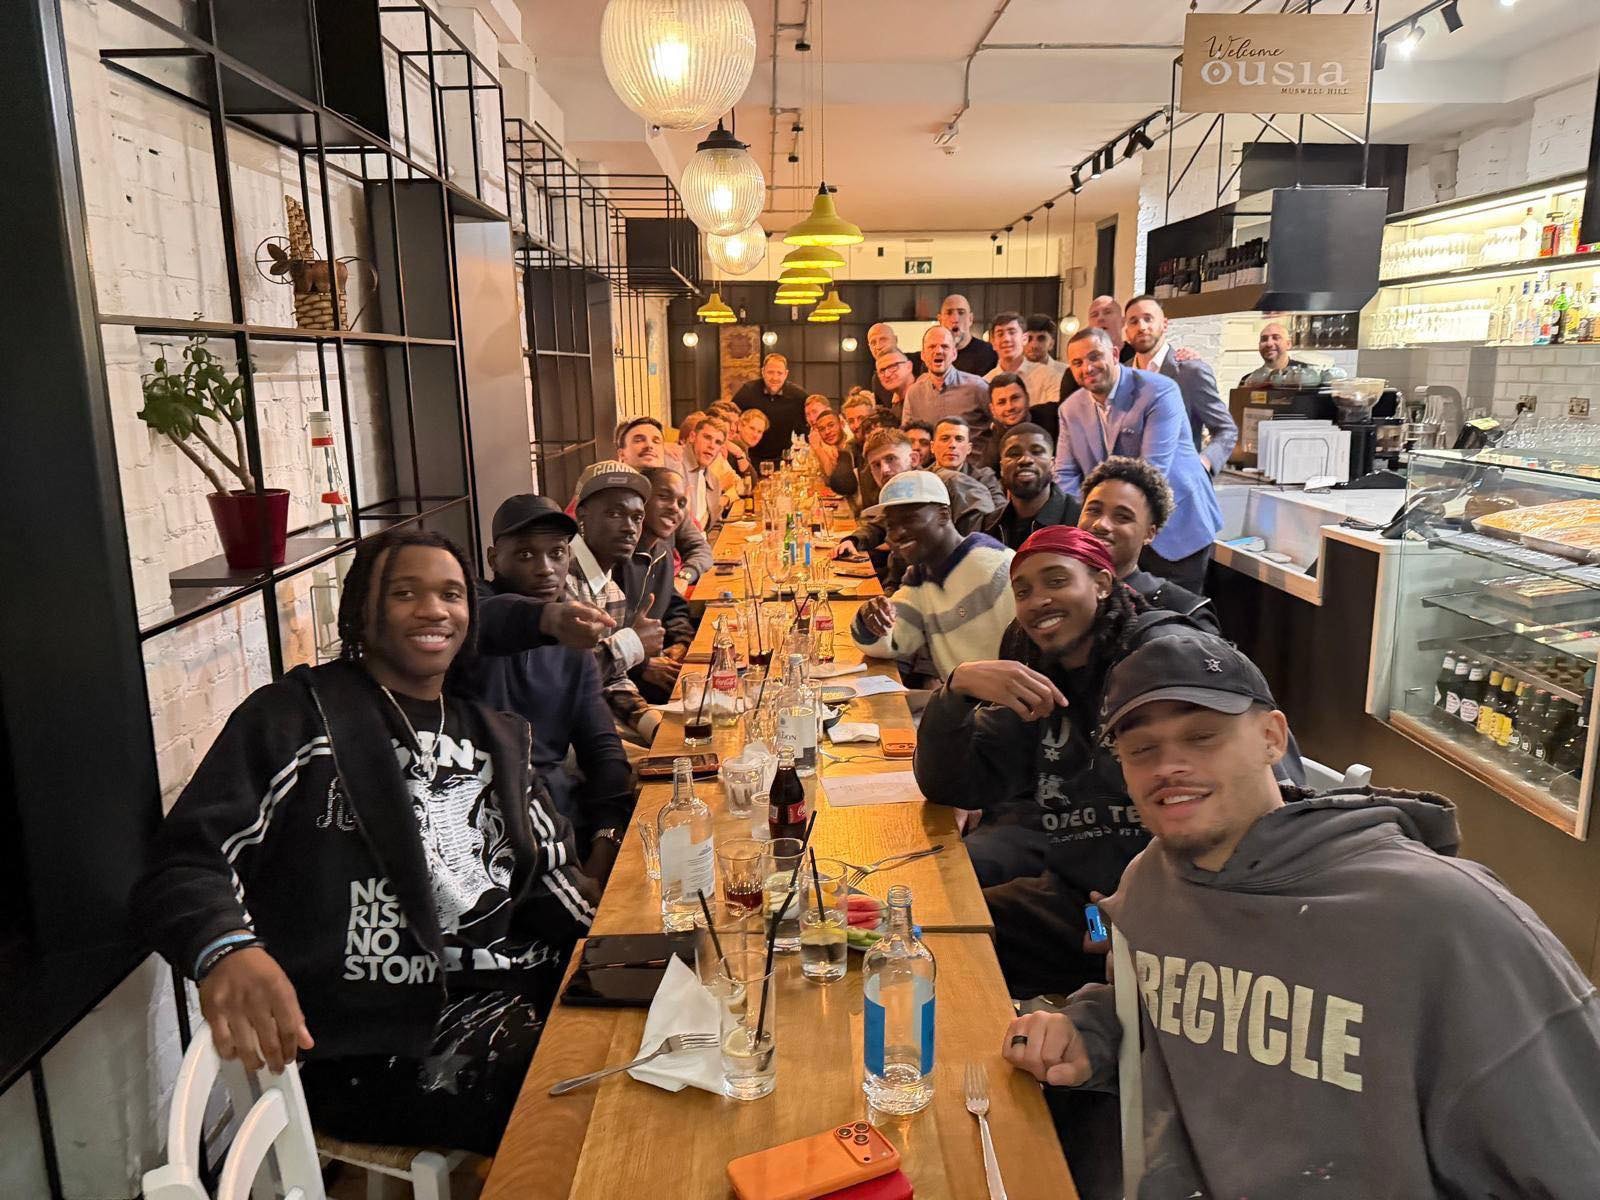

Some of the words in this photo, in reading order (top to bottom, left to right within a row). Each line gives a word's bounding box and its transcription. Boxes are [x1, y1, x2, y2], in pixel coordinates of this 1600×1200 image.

[1205, 35, 1285, 60] Welcome
[1326, 87, 1350, 95] HILL
[344, 928, 400, 956] NO
[342, 955, 440, 984] STORY
[1136, 950, 1363, 1092] RECYCLE
